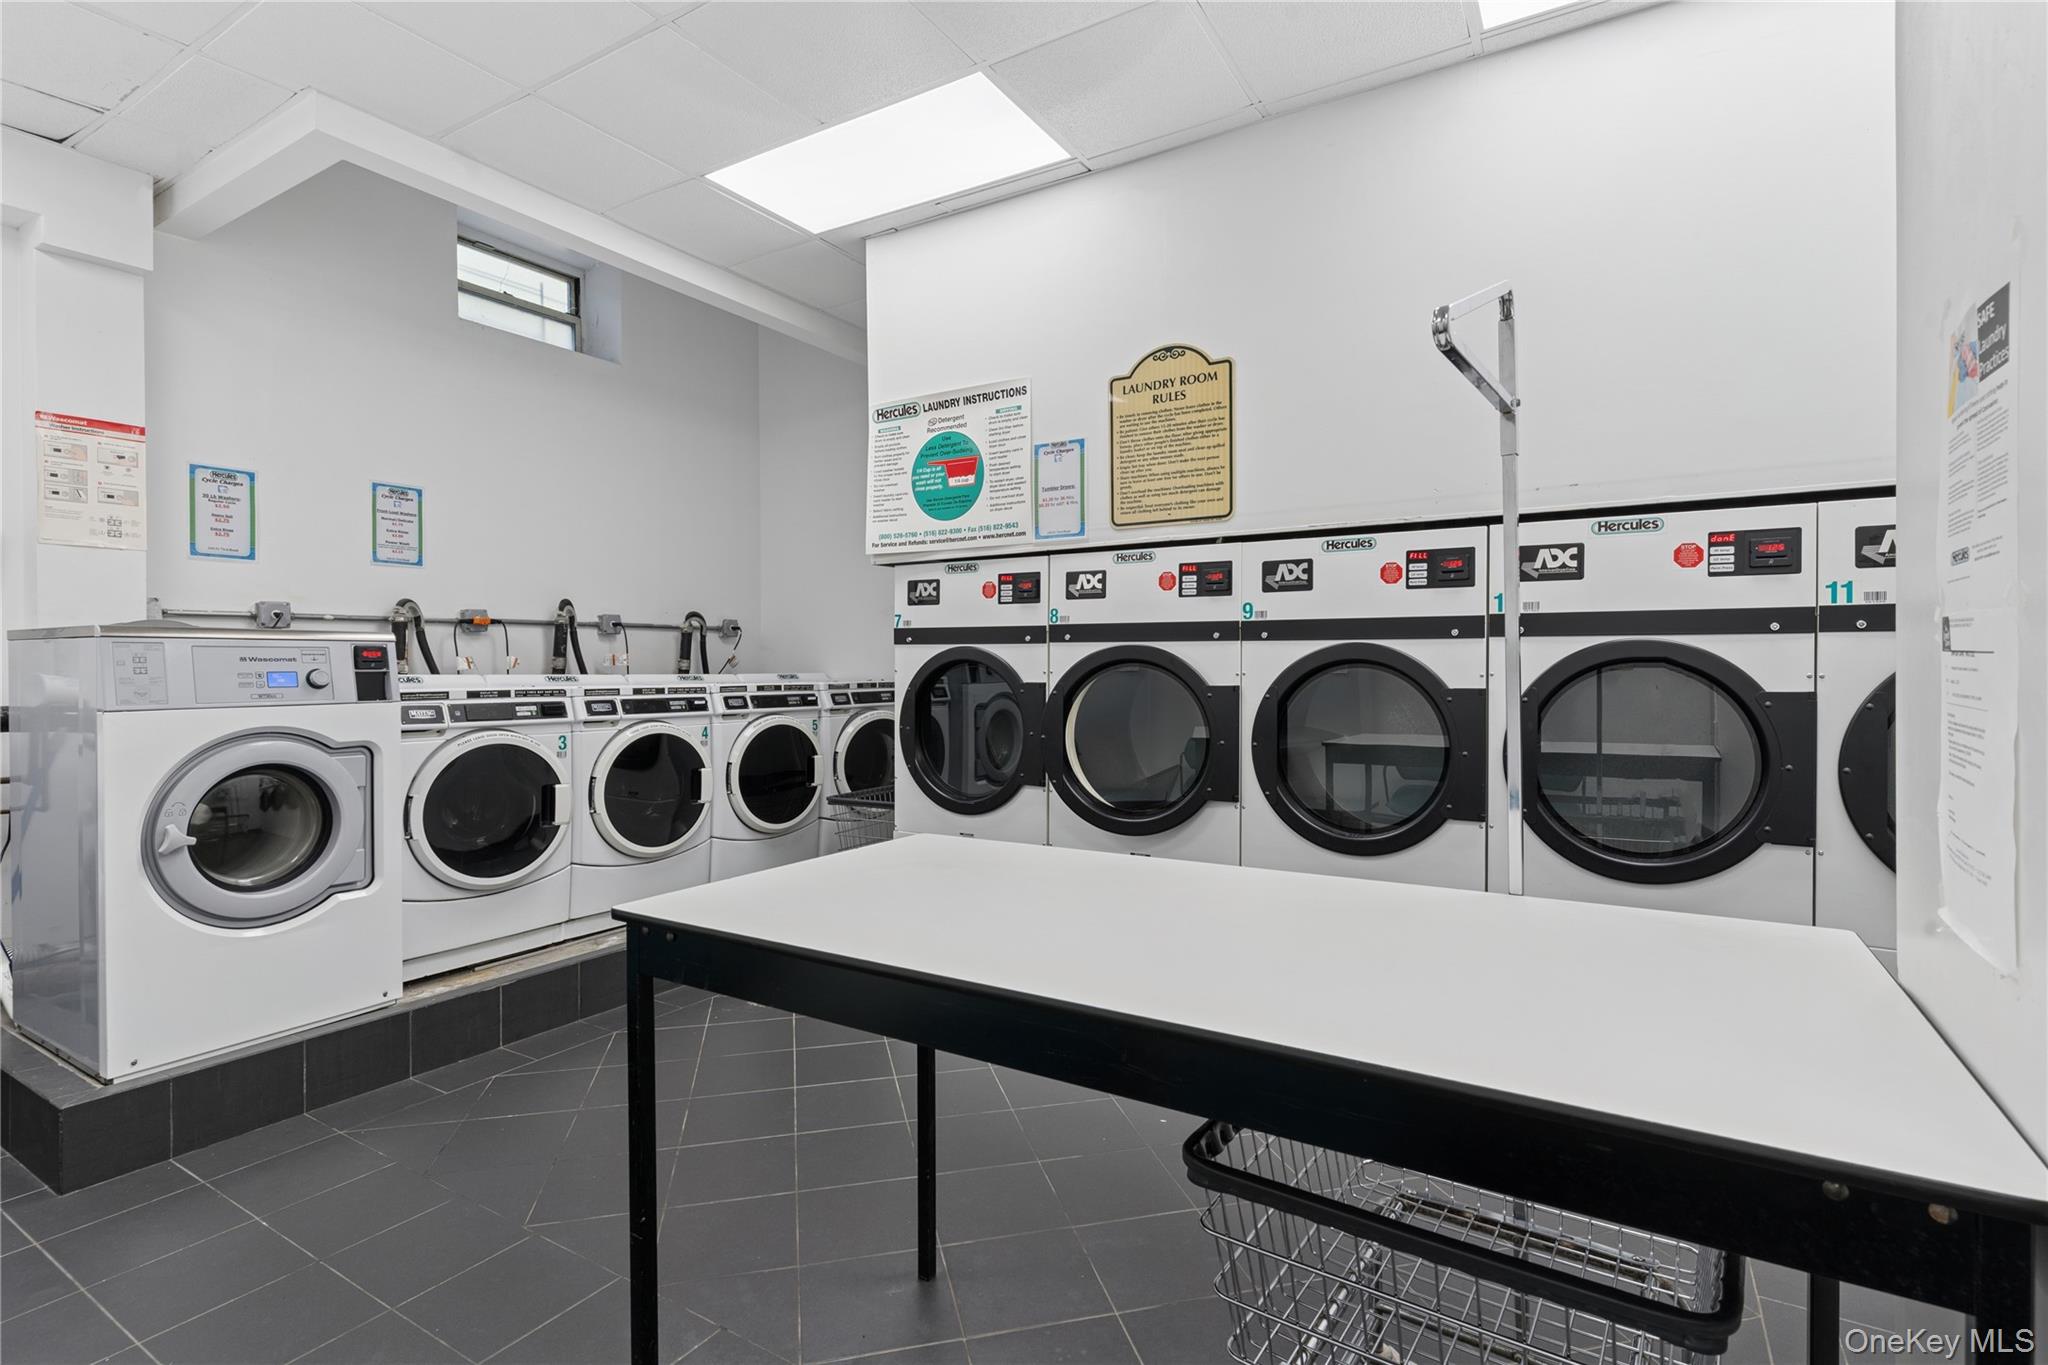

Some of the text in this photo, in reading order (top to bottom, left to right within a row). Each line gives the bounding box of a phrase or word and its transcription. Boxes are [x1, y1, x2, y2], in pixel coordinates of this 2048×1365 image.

[1122, 371, 1218, 395] LAUNDRY ROOM
[876, 386, 1027, 421] Hercules LAUNDRY INSTRUCTIONS
[1152, 390, 1186, 404] RULES
[938, 414, 965, 424] Detergent
[927, 422, 968, 434] Recommended
[202, 476, 243, 487] Cycle Charges
[212, 471, 238, 480] Hercules
[1597, 518, 1659, 532] Hercules
[983, 531, 1026, 539] www.hercnet.com
[1326, 538, 1373, 551] Hercules
[1116, 552, 1153, 563] Hercules
[1409, 552, 1428, 560] FILL
[1534, 546, 1578, 568] ADC
[947, 563, 977, 573] Hercules
[1274, 562, 1309, 581] ADC
[1076, 573, 1103, 590] ADC
[916, 582, 937, 597] ADC
[1825, 580, 1853, 604] 11
[1494, 592, 1504, 613] 1
[1050, 608, 1058, 623] 8
[1242, 602, 1254, 619] 9
[894, 614, 902, 628] 7
[398, 676, 421, 684] cules
[812, 720, 818, 731] 5
[702, 726, 709, 740] 4
[558, 735, 567, 750] 3
